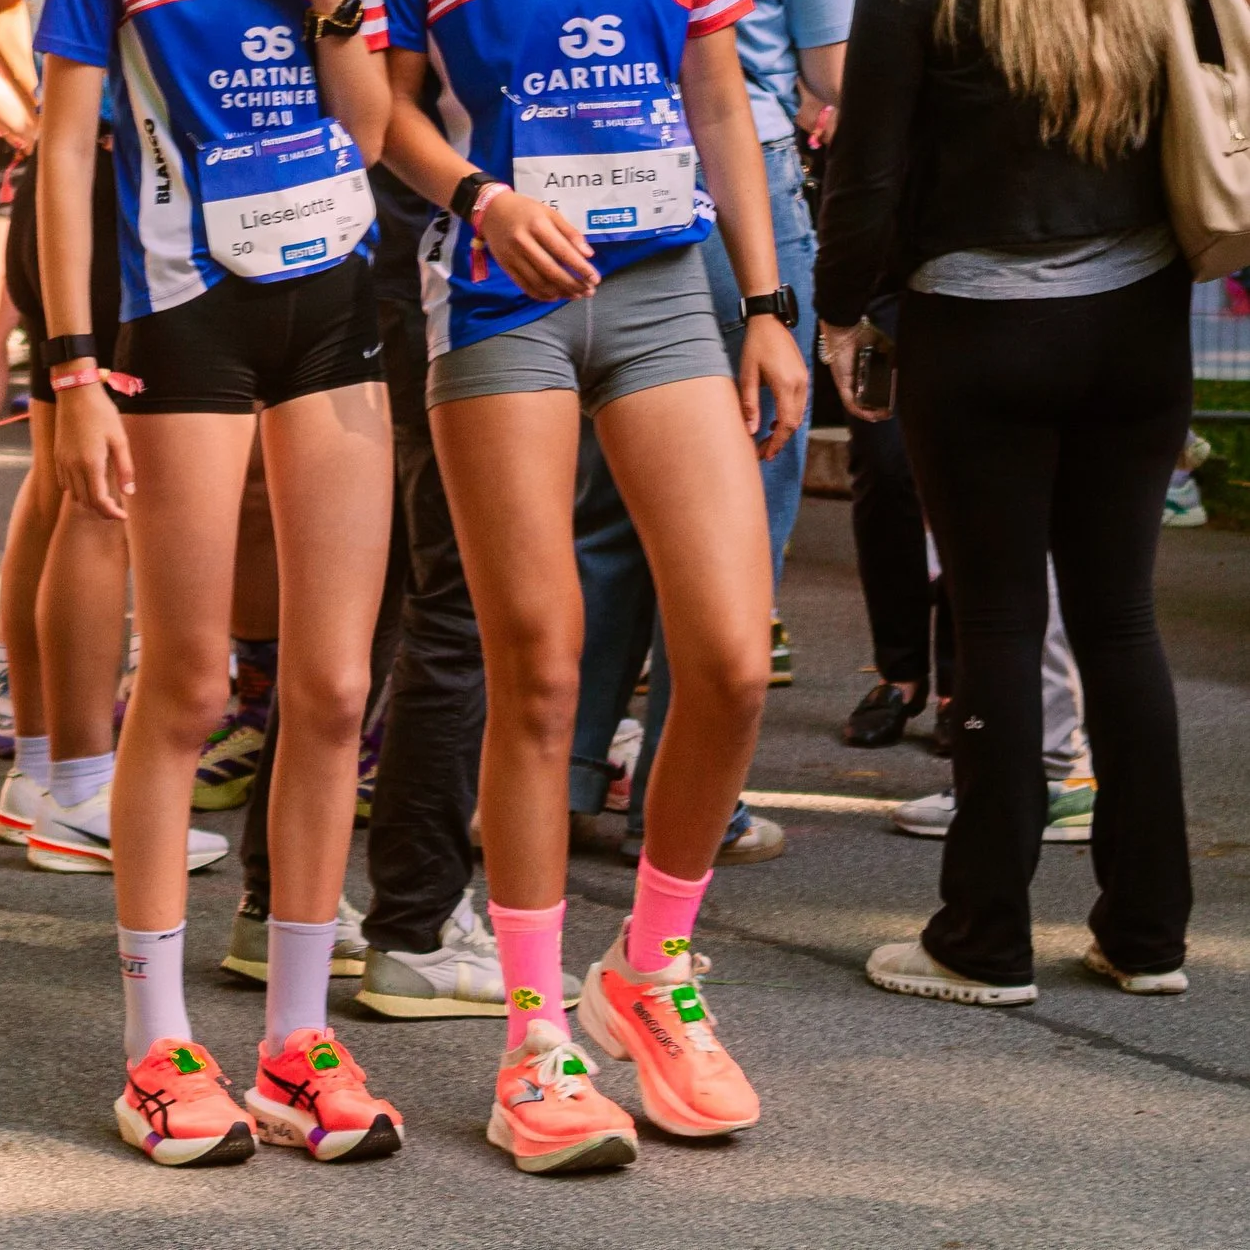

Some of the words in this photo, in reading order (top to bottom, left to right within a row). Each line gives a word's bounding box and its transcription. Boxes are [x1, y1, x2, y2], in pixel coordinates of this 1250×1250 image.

[208, 66, 316, 90] GARTNE
[523, 62, 661, 96] GARTNER
[251, 110, 294, 128] BAU
[544, 171, 603, 189] Anna
[611, 167, 658, 185] Elisa
[240, 197, 336, 230] Lieselotte
[231, 240, 255, 257] 50
